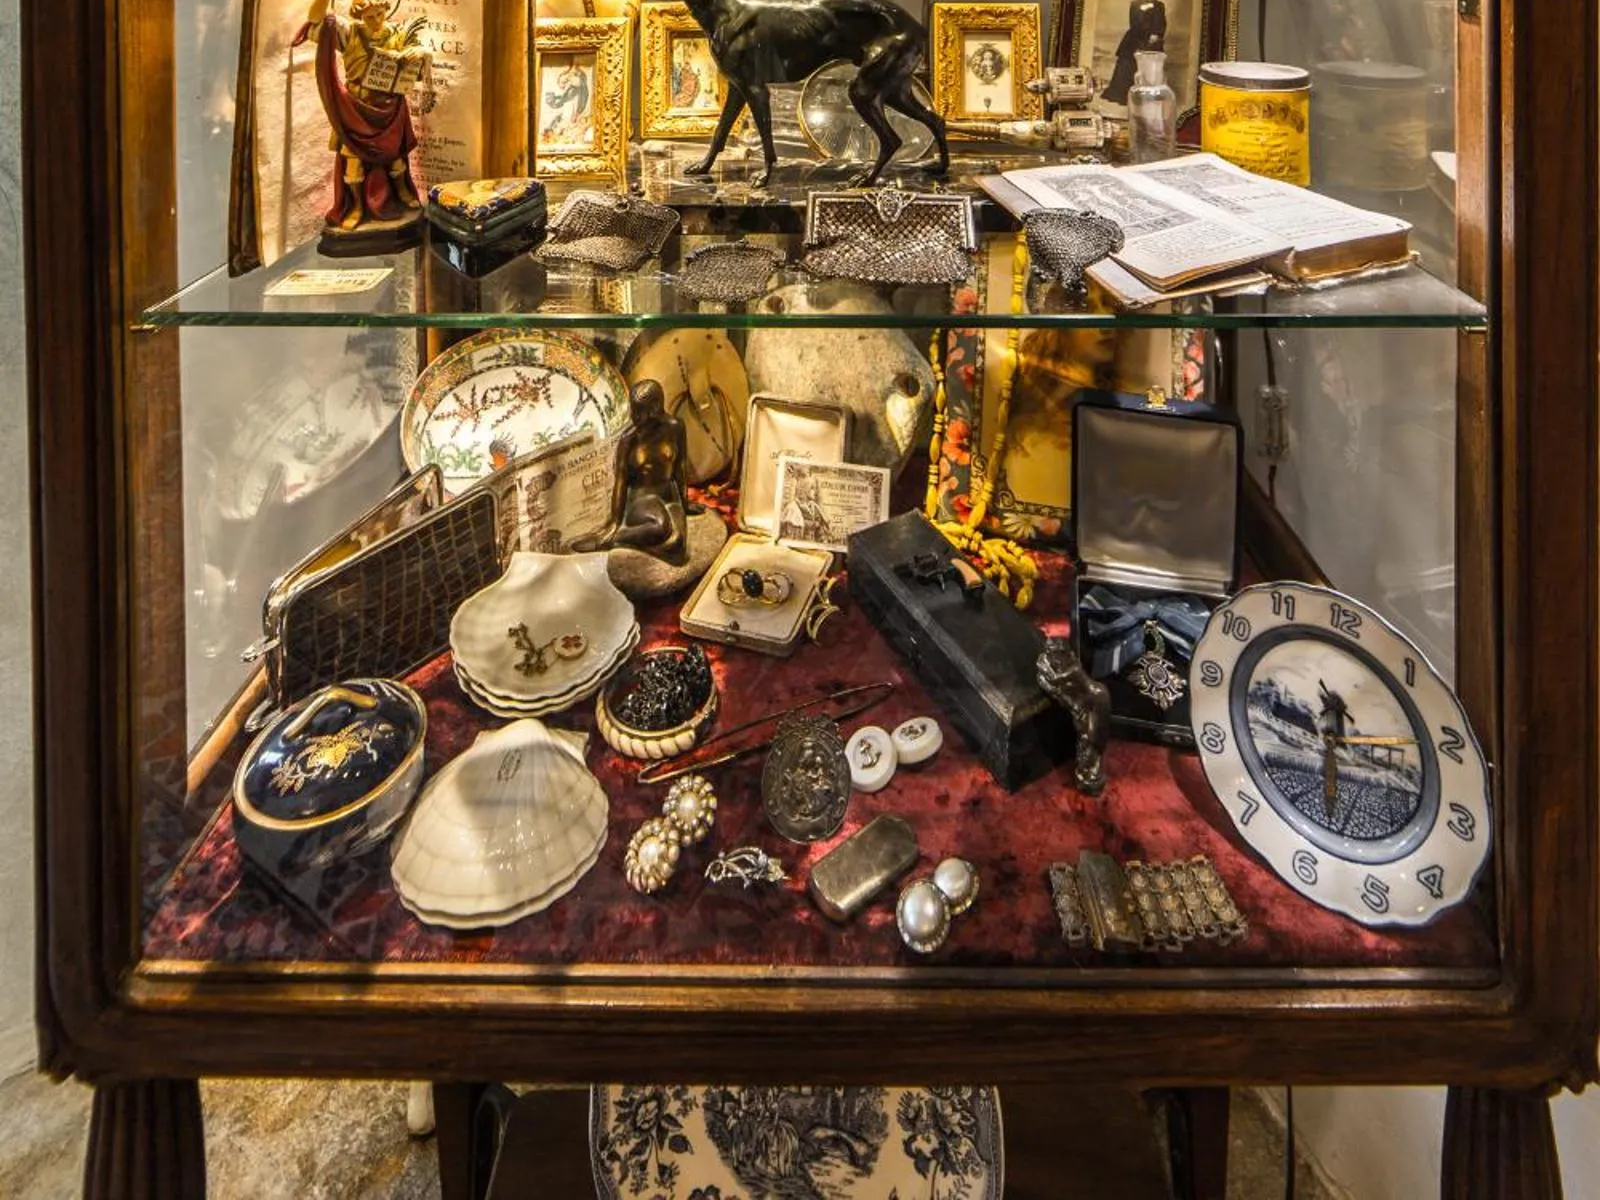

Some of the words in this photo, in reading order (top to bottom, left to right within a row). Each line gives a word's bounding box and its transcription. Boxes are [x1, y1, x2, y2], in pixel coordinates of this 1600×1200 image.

[1271, 591, 1295, 620] 11
[1330, 603, 1363, 639] 12
[1221, 609, 1251, 642] 10
[1200, 660, 1224, 687] 9
[1404, 657, 1416, 687] 1
[1199, 723, 1227, 754] 8
[1438, 726, 1467, 764] 2
[1237, 791, 1260, 826] 7
[1447, 802, 1476, 842] 3
[1292, 848, 1319, 885] 6
[1416, 863, 1444, 900] 4
[1361, 874, 1391, 914] 5
